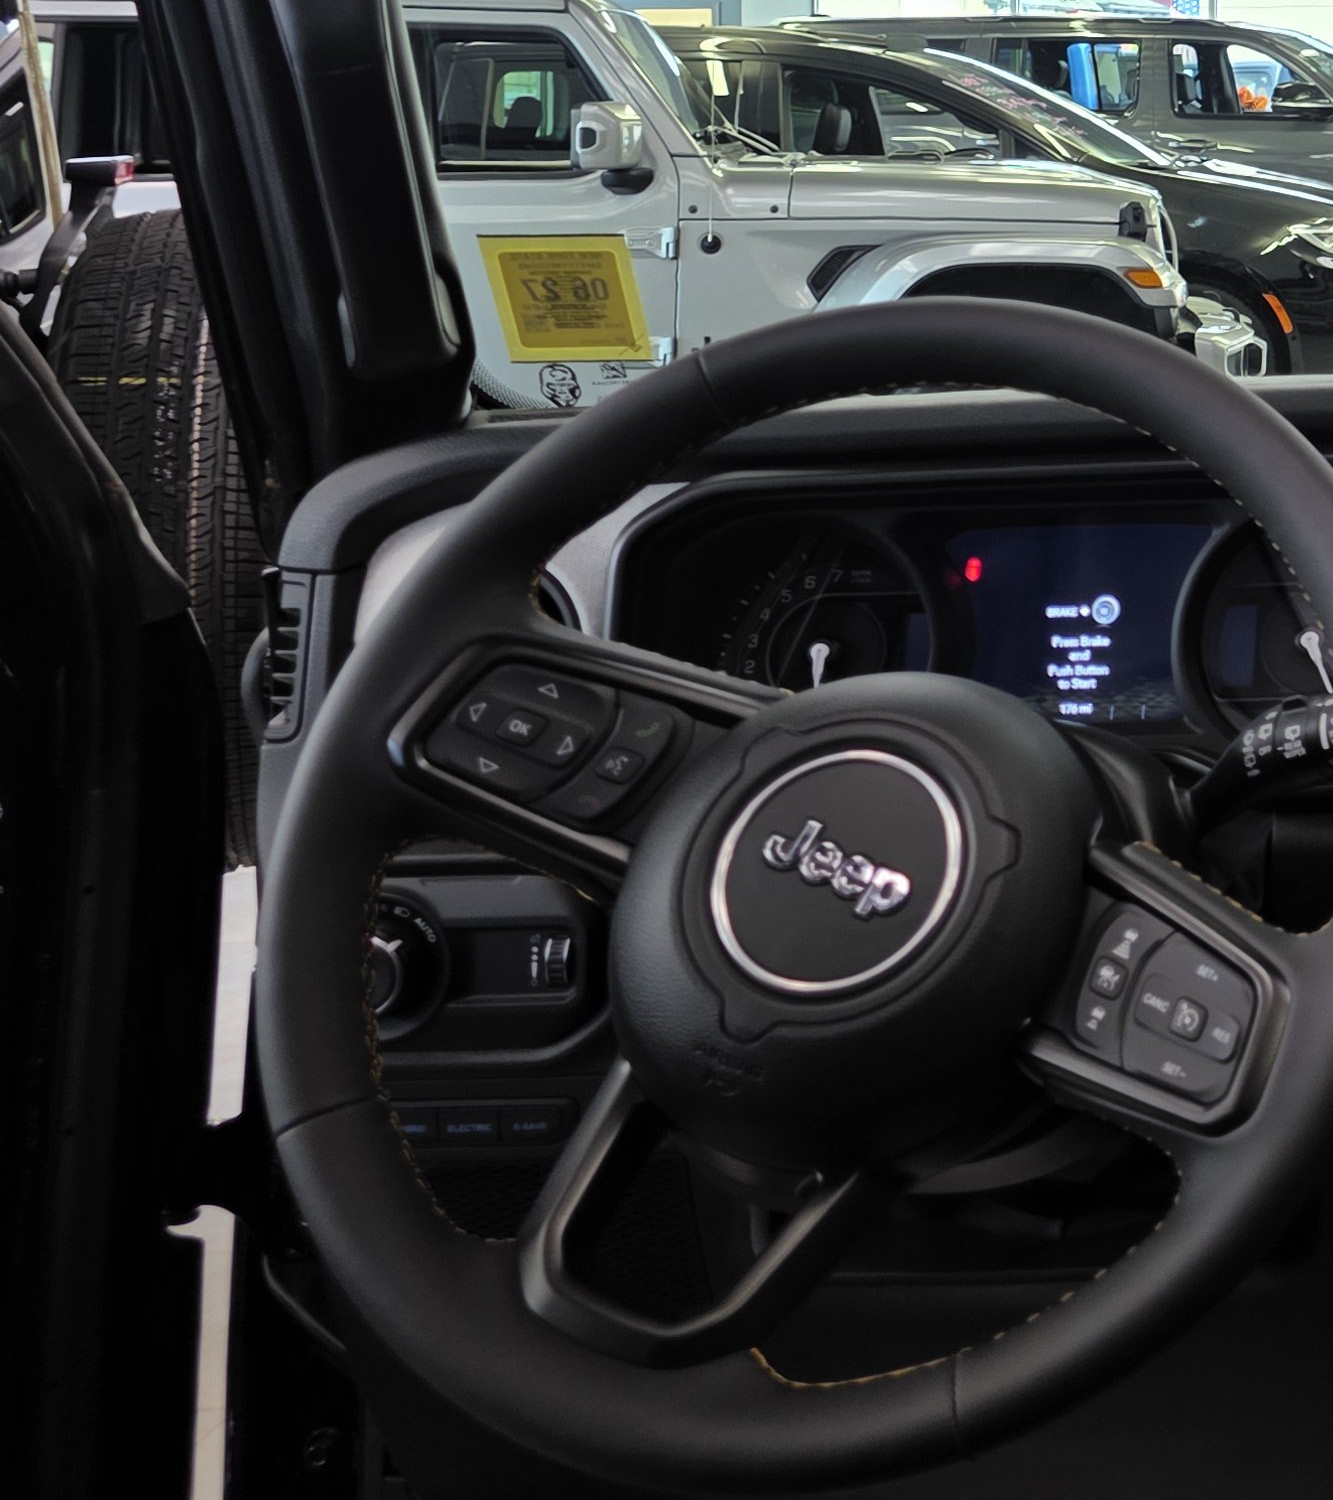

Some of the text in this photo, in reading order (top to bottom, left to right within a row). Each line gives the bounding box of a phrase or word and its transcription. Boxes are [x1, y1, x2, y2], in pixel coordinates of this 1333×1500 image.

[804, 575, 817, 589] 6
[832, 568, 844, 583] 7
[780, 589, 793, 603] 5
[760, 608, 771, 620] 4
[1045, 605, 1079, 618] BRAKE
[748, 634, 760, 648] 3
[1050, 633, 1112, 648] Press Brake
[1067, 649, 1091, 662] and
[744, 660, 757, 675] 2
[1047, 663, 1111, 677] Push Button
[1056, 677, 1098, 690] to Start
[509, 719, 532, 736] OK
[762, 819, 912, 916] Jeep
[414, 917, 437, 943] AUTO
[1142, 992, 1171, 1013] CANC
